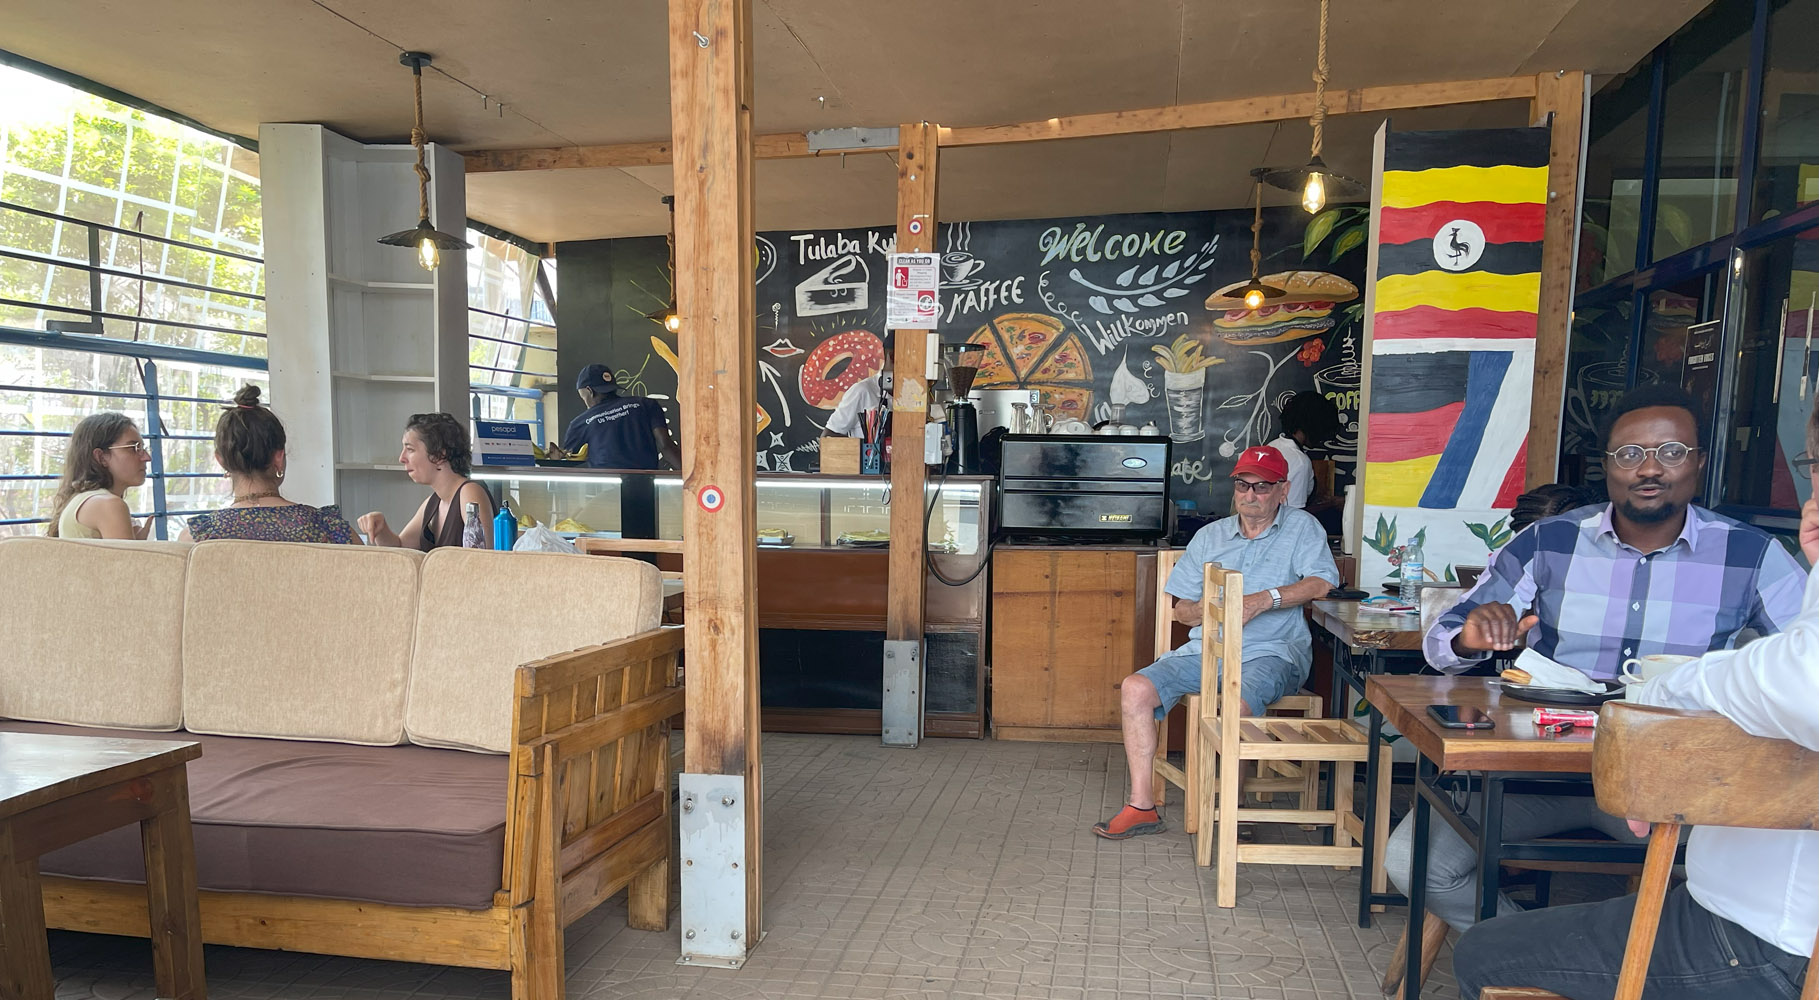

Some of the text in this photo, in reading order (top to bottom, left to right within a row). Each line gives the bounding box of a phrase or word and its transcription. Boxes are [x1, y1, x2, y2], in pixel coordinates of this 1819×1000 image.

[790, 232, 861, 265] Tulaba
[946, 275, 1025, 324] KAFFEE
[585, 403, 641, 425] Communication Brings
[605, 410, 630, 422] Together!
[491, 426, 517, 434] pesapal
